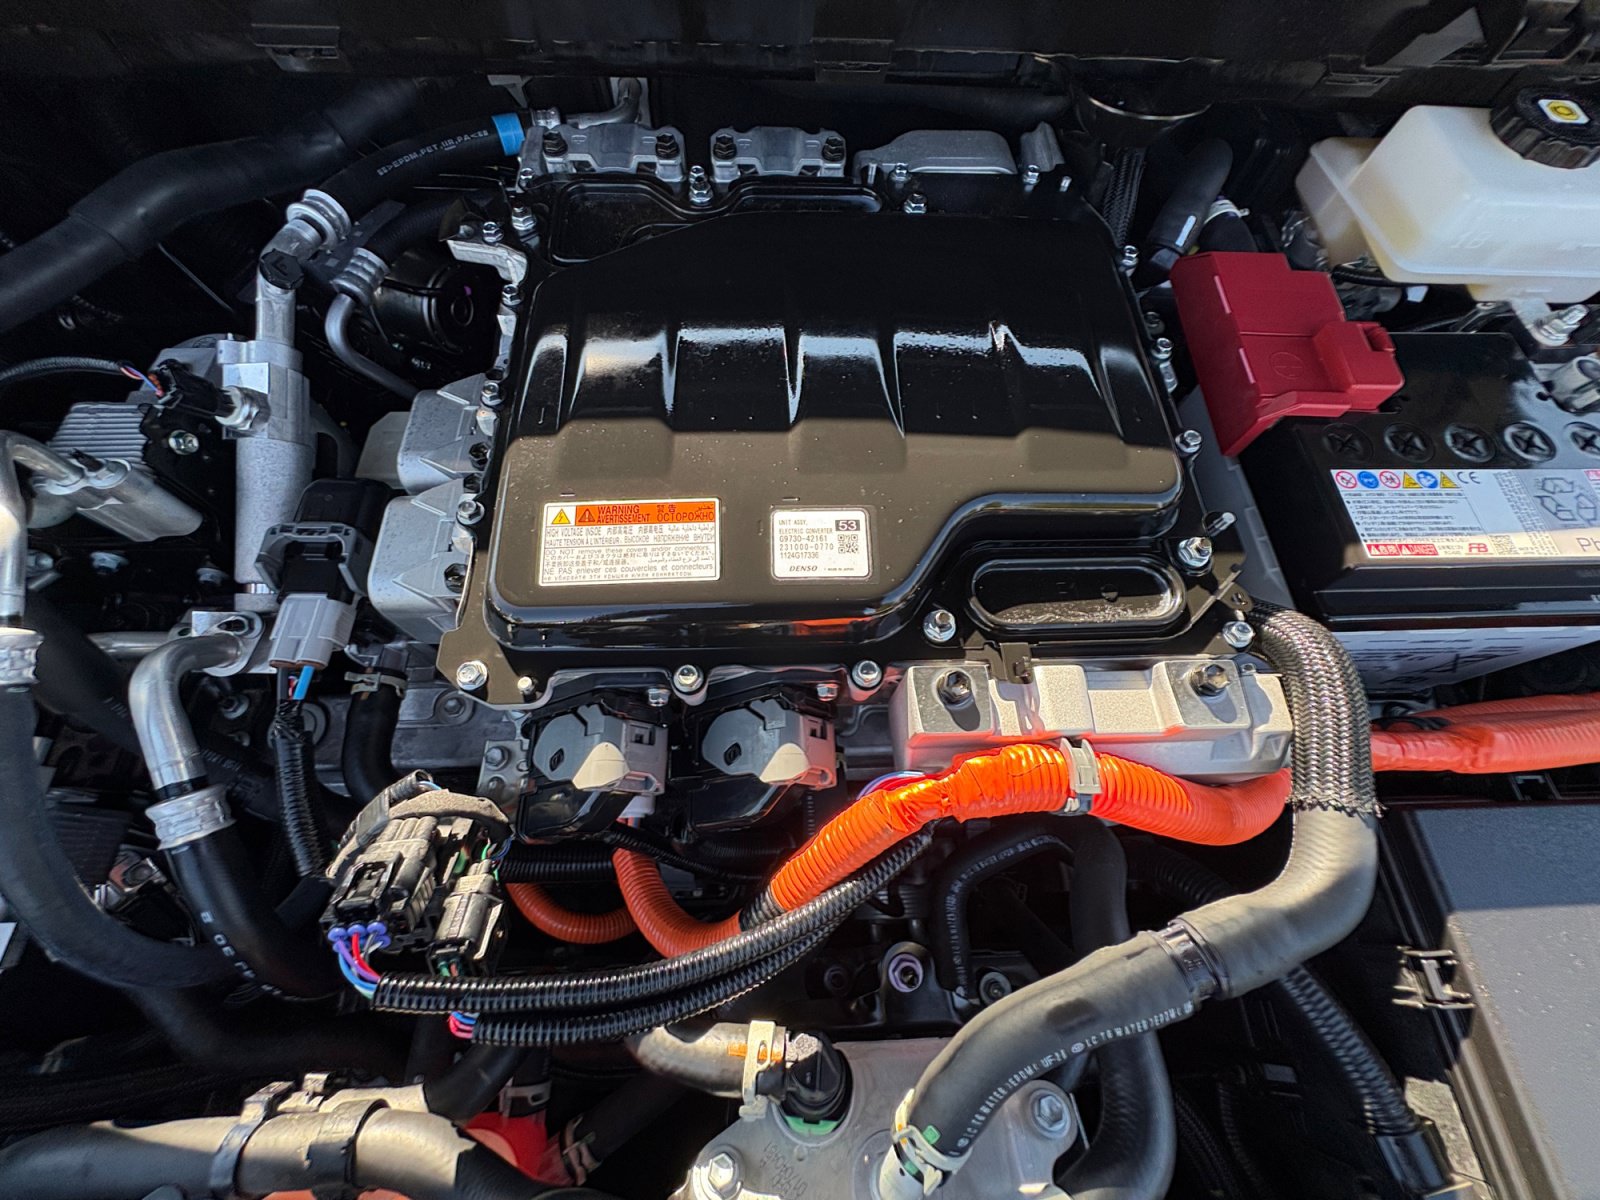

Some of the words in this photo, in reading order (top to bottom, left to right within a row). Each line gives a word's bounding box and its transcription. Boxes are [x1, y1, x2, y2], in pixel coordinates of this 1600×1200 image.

[597, 505, 639, 514] WARNING
[656, 504, 676, 512] 警告
[597, 513, 650, 523] AVERTISSEMENT
[656, 511, 713, 521] ОСТОРОЖНО
[838, 520, 857, 531] 53
[546, 528, 558, 537] HIGH
[560, 527, 582, 536] VOLTAGE
[546, 538, 562, 546] HAUTE
[563, 537, 584, 545] TENSION
[779, 543, 834, 551] 231000-0770
[1409, 545, 1437, 555] DANGER
[620, 564, 657, 572] couvercles
[671, 562, 713, 570] connecteurs
[979, 1086, 1008, 1114] WATER
[1114, 1019, 1149, 1037] WATER
